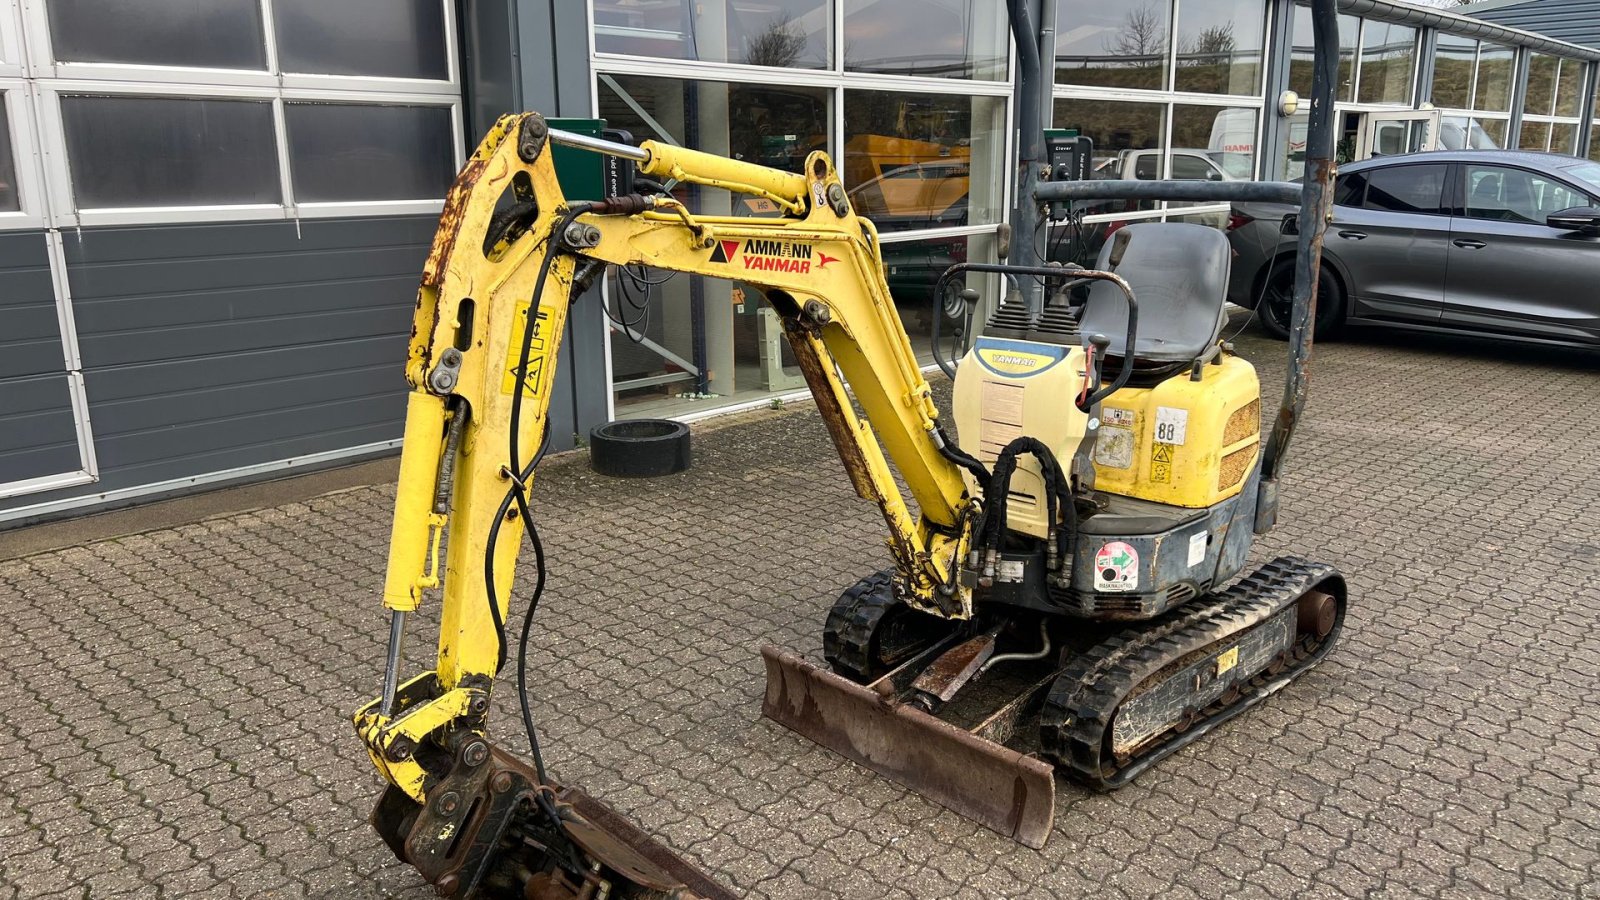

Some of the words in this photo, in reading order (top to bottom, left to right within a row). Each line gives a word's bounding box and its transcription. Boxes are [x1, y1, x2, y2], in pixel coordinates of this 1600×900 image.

[743, 239, 812, 259] AMMANN
[743, 255, 811, 274] YANMAR
[992, 354, 1037, 367] YANMAR
[1158, 422, 1175, 441] 88
